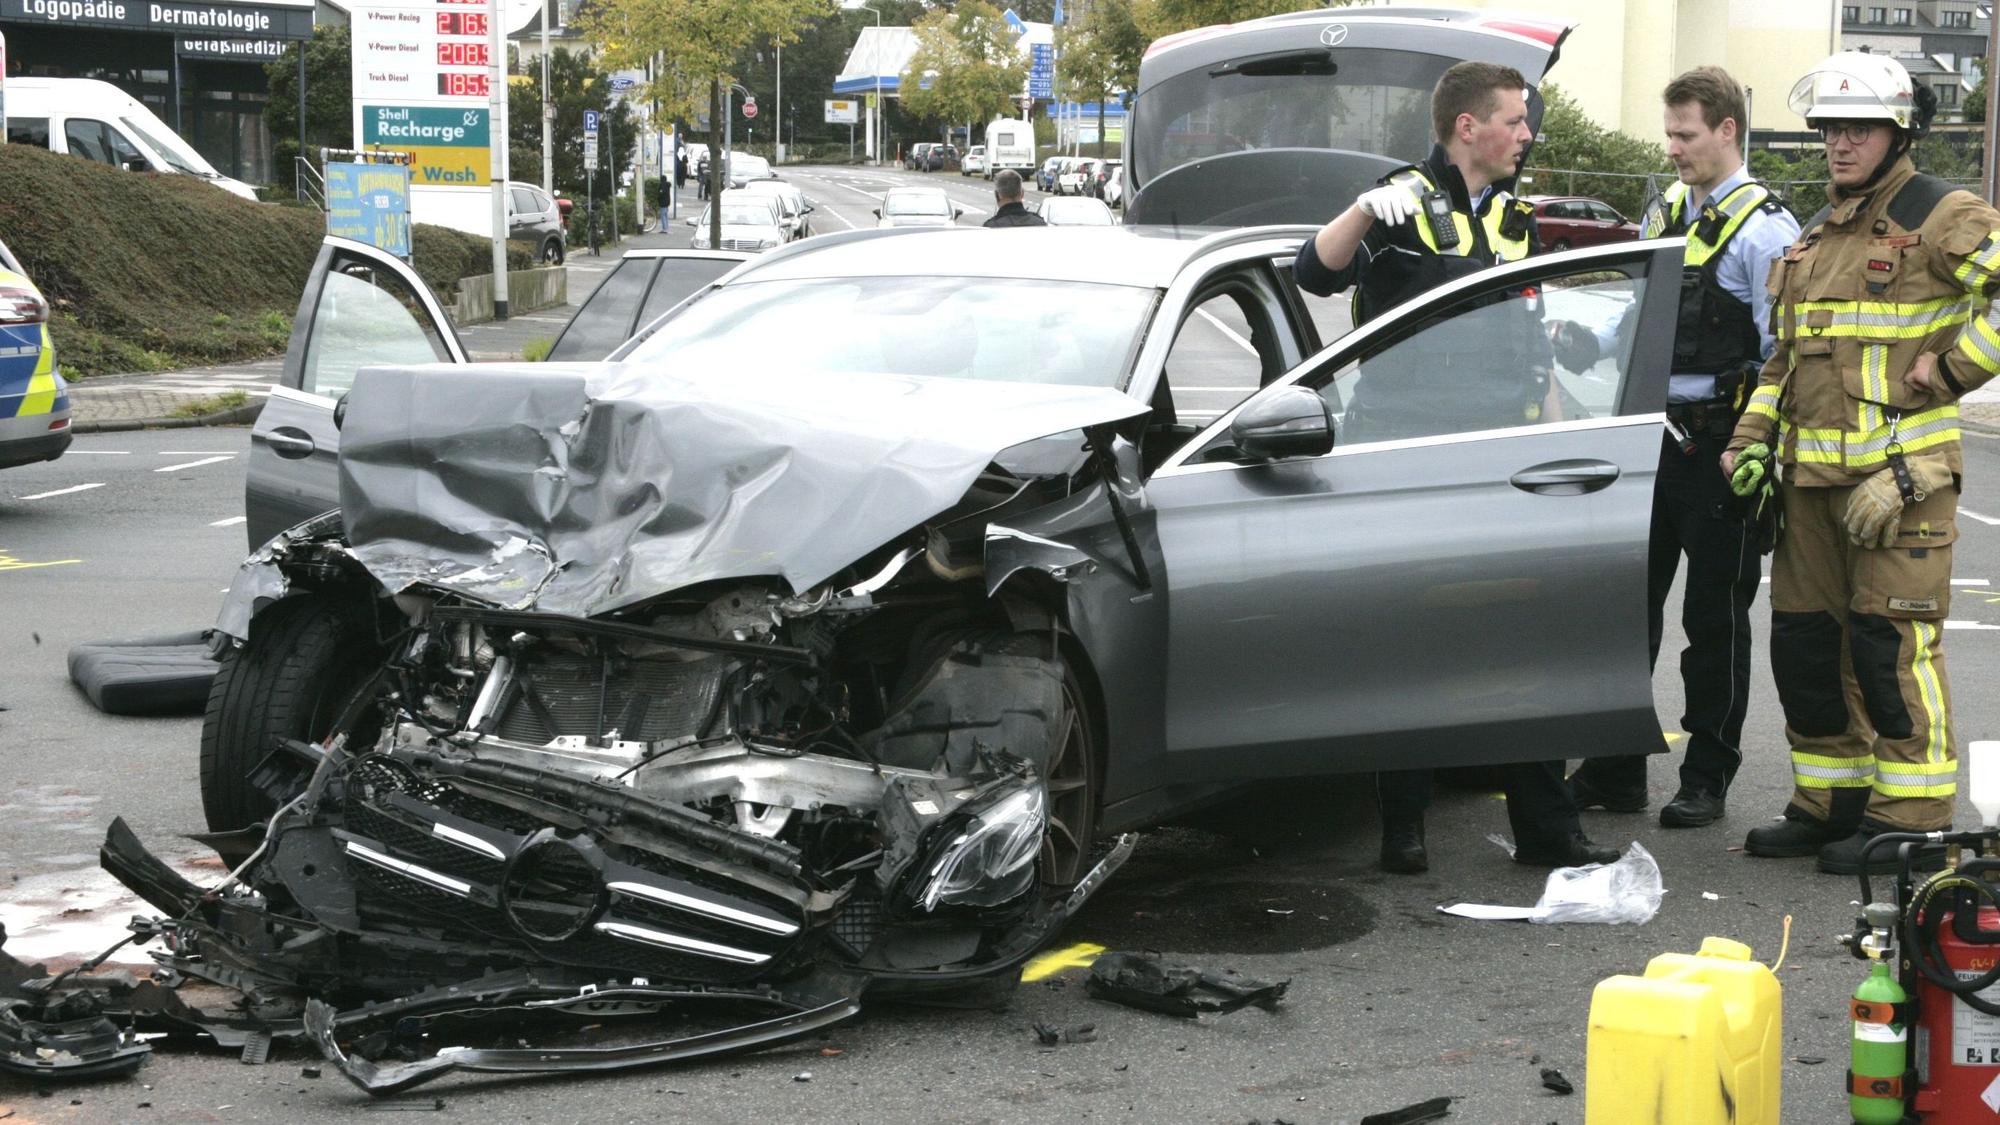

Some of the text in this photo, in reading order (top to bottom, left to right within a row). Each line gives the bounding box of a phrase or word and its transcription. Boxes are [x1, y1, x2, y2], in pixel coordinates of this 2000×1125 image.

[23, 0, 126, 20] Logopädie
[150, 4, 270, 31] Dermatologie
[367, 12, 396, 21] V-Power
[398, 13, 421, 23] Racing
[368, 43, 397, 51] V-Power
[398, 43, 419, 52] Diesel
[368, 73, 386, 81] Truck
[388, 74, 409, 82] Diesel
[1840, 79, 1849, 91] A
[378, 108, 409, 120] Shell
[378, 121, 465, 142] Recharge
[422, 166, 477, 182] Wash
